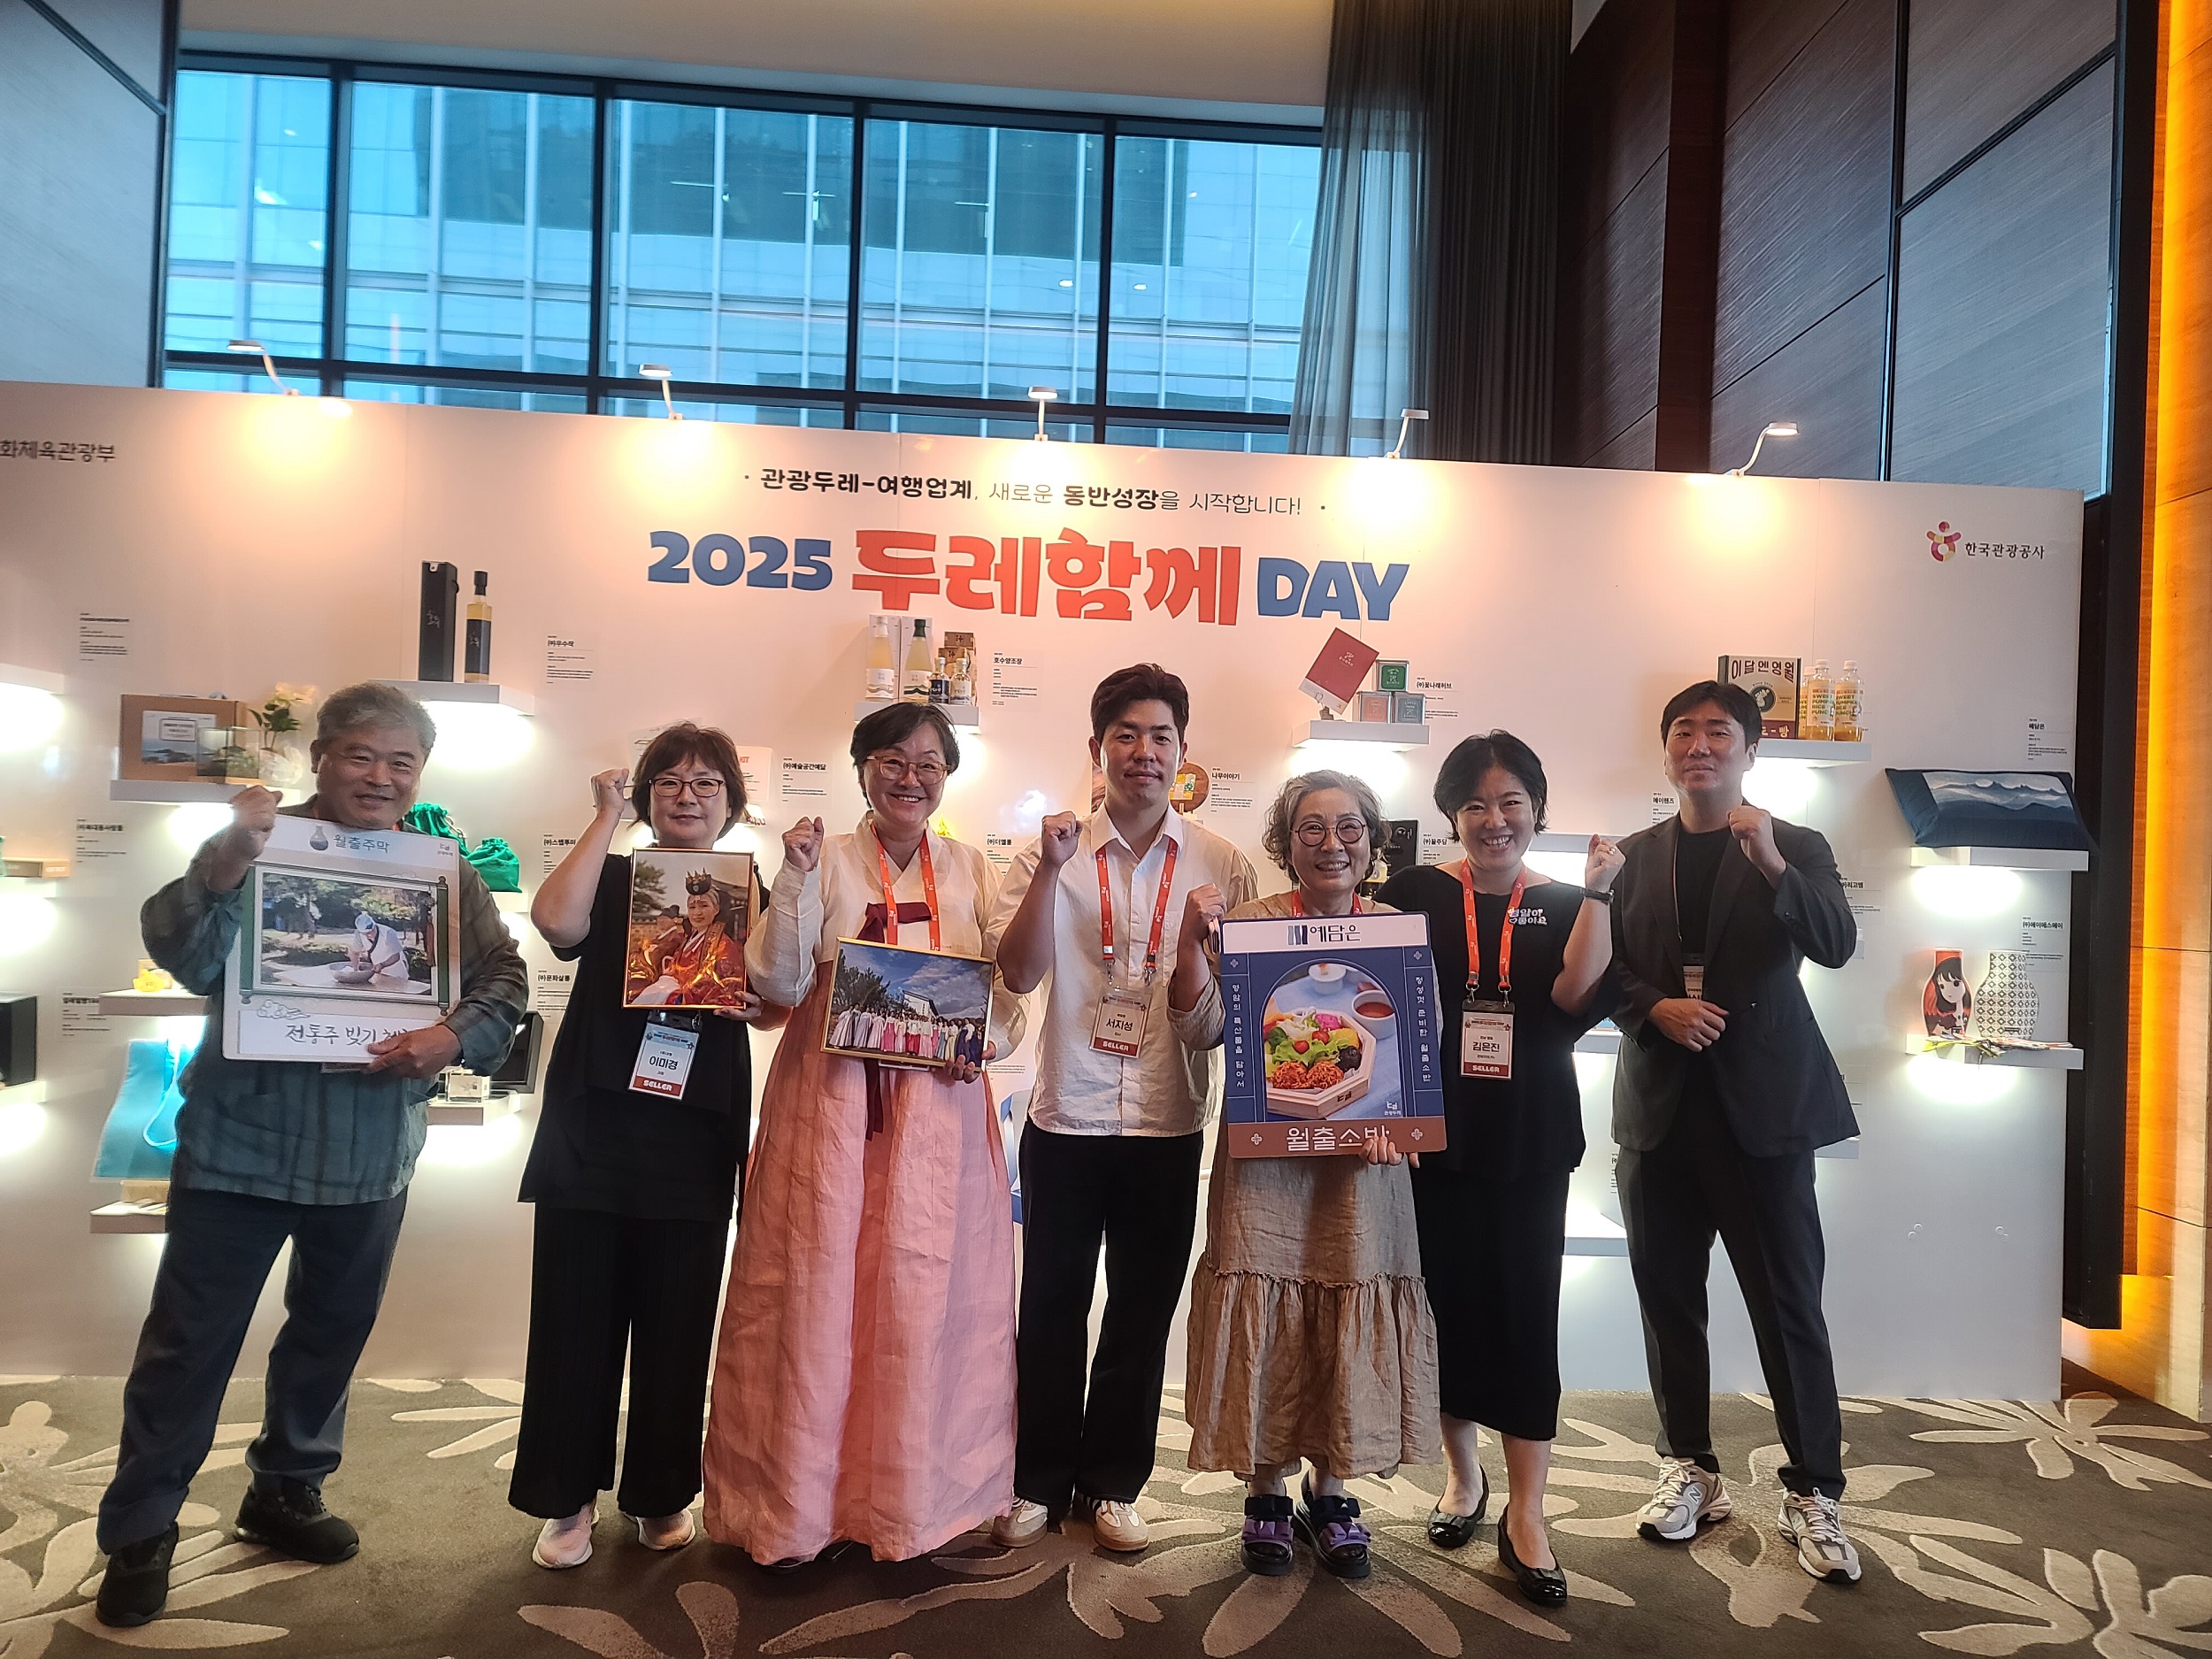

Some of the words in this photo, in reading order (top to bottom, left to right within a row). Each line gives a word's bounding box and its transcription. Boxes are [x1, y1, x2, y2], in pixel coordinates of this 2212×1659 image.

[989, 483, 1053, 503] 새로운
[1063, 485, 1180, 511] 동반성장을
[1189, 492, 1302, 516] 시작합니다!
[1964, 542, 2045, 560] 한국관광공사
[648, 530, 833, 591] 2025
[851, 527, 1241, 626] 두레함께
[1257, 557, 1410, 621] DAY
[1731, 659, 1794, 684] 이달엔영월
[1211, 772, 1240, 780] 나무이야기
[333, 833, 390, 855] 월출주막
[1310, 924, 1361, 943] 예담은
[1232, 984, 1241, 1011] 영암의
[1415, 976, 1425, 1004] 정성껏
[1106, 1018, 1133, 1032] 서지성
[1417, 1009, 1428, 1037] 준비한
[285, 1024, 340, 1046] 전통주
[344, 1025, 378, 1046] 빚기
[1102, 1041, 1129, 1051] SELLER
[1233, 1017, 1243, 1054] 특산물을
[1472, 1041, 1501, 1053] 김은진
[649, 1056, 679, 1071] 이미경
[1420, 1044, 1432, 1082] 월출소반
[1471, 1064, 1501, 1073] SELLER
[642, 1079, 672, 1092] SELLER
[1235, 1061, 1245, 1088] 담아서
